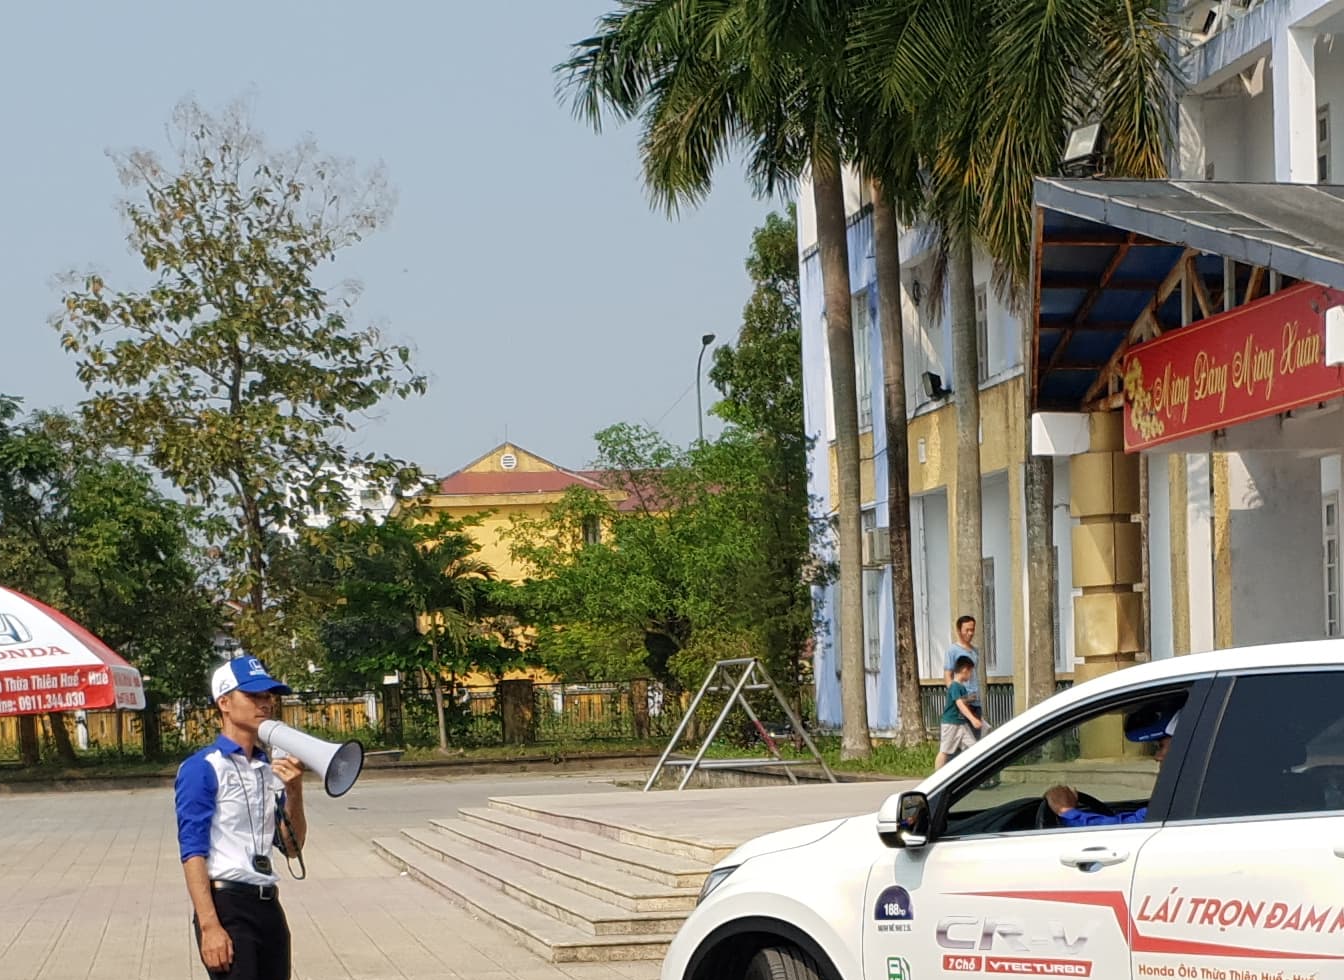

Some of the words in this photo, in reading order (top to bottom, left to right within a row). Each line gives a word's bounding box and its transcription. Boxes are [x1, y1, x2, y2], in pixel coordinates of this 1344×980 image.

[1280, 320, 1320, 375] Xuân
[18, 692, 86, 711] 0911.344.030
[1137, 885, 1183, 923] LÁI
[1187, 898, 1265, 932] TRỌN
[1263, 903, 1332, 933] ĐAM
[936, 915, 1100, 955] CR-V
[990, 961, 1032, 972] VTEC
[1032, 963, 1087, 974] TURBO
[1138, 964, 1174, 977] Honda
